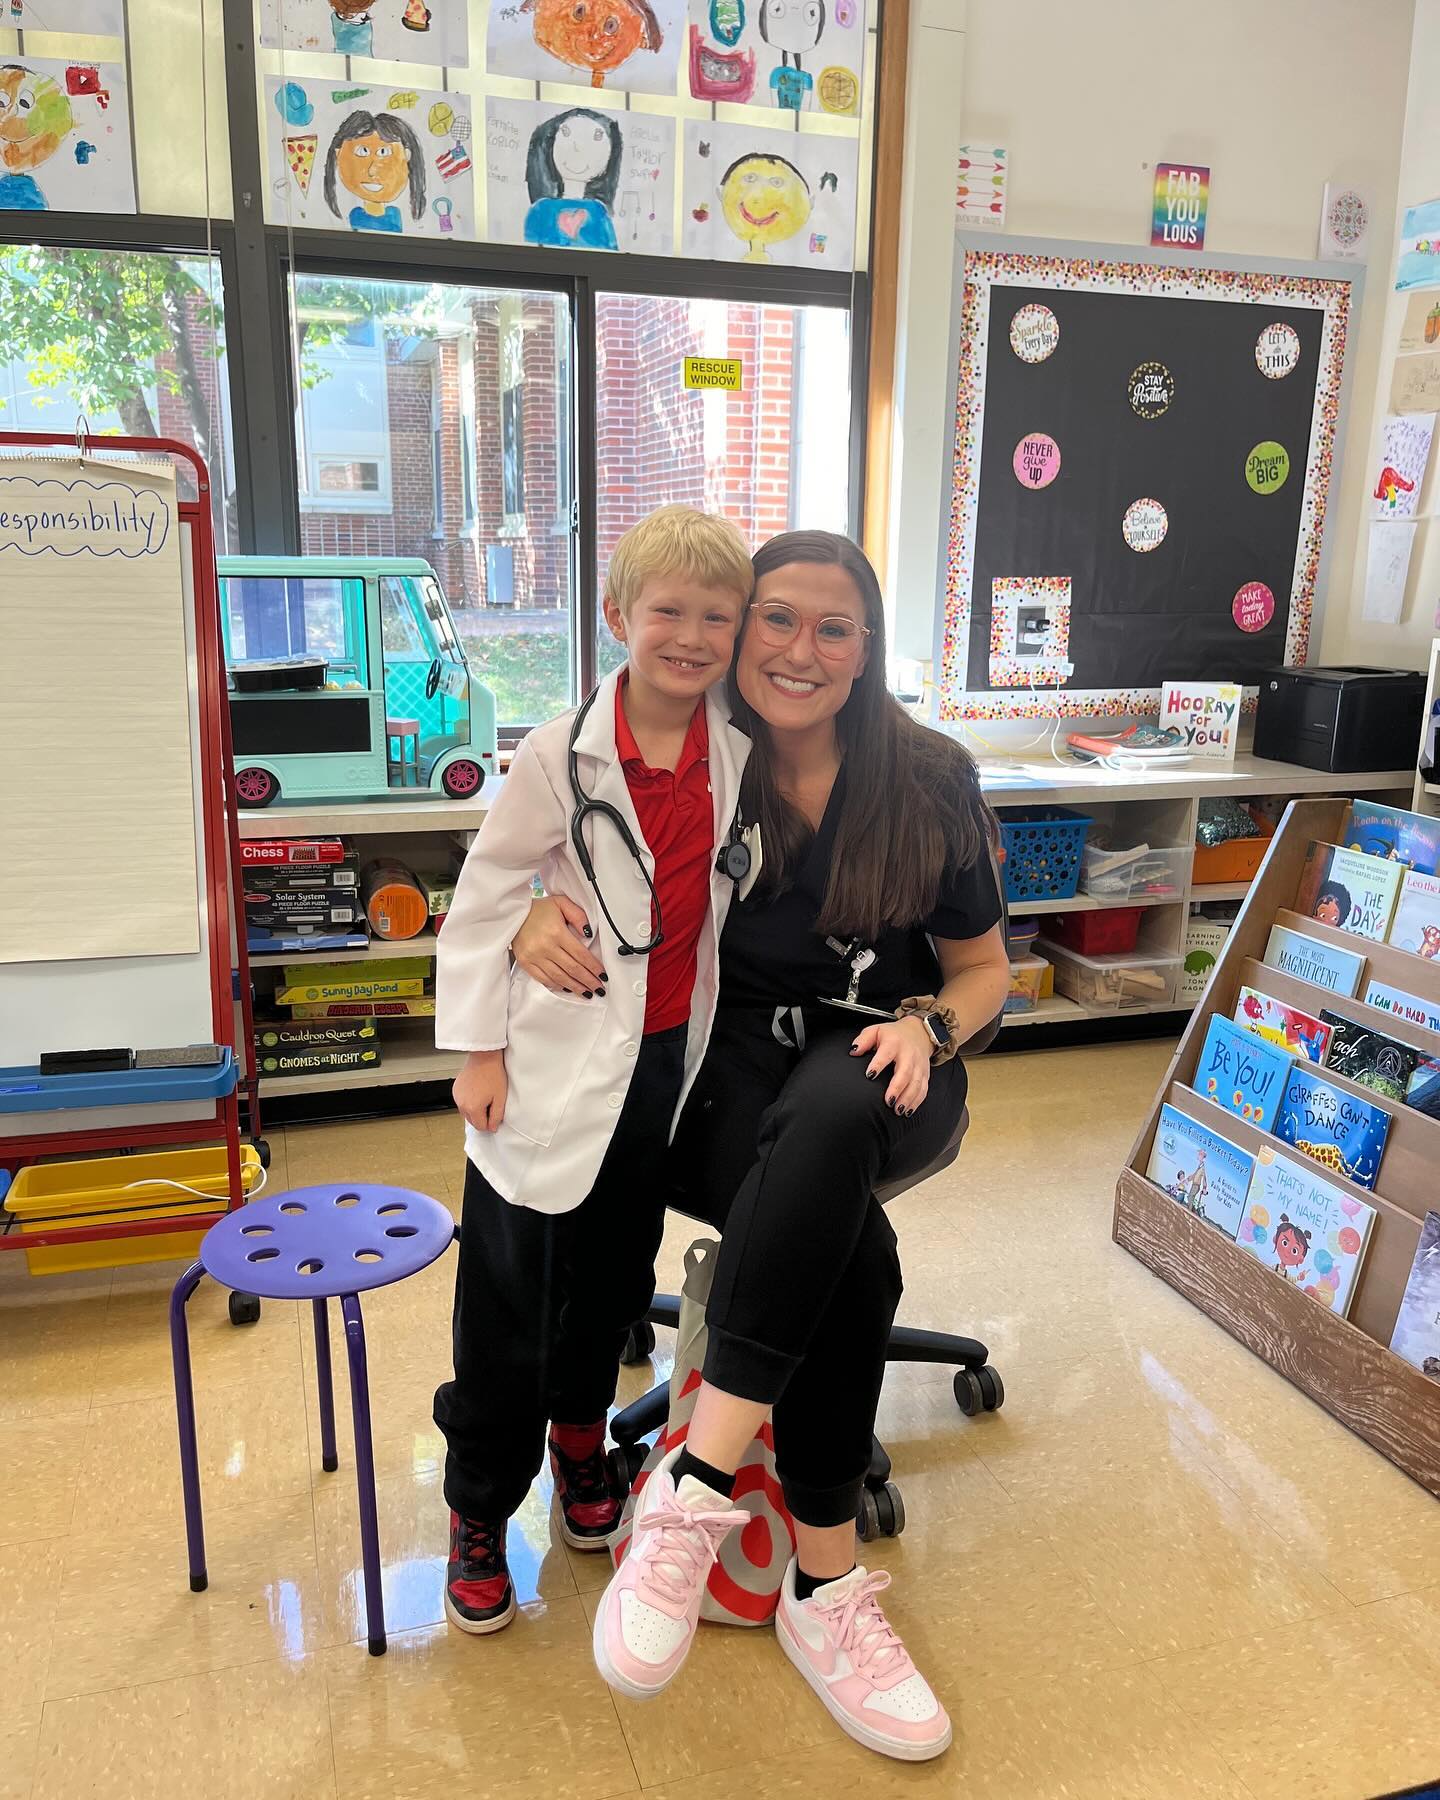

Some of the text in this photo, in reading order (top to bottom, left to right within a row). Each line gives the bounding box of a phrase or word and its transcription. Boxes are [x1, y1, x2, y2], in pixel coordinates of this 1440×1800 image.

[1167, 170, 1201, 196] FAB
[1166, 197, 1200, 223] YOU
[1163, 223, 1198, 244] LOUS
[1269, 331, 1287, 345] LET'S
[691, 362, 735, 374] RESCUE
[1265, 354, 1290, 368] THIS
[691, 374, 736, 386] WINDOW
[1144, 375, 1164, 386] STAY
[1132, 383, 1168, 406] Positive
[1023, 441, 1053, 458] NEVER
[1022, 456, 1047, 471] give
[1249, 455, 1285, 473] Dream
[1256, 465, 1279, 485] BIG
[0, 500, 155, 548] esponsibility
[1241, 589, 1262, 604] MAKE
[1243, 610, 1265, 626] GREAT
[1381, 815, 1392, 825] on
[243, 847, 284, 858] Chess
[275, 893, 296, 901] Solar
[297, 892, 326, 902] System
[1364, 890, 1384, 909] THE
[1351, 904, 1380, 933] DAY
[1298, 945, 1310, 957] THE
[1277, 949, 1340, 989] MAGNIFICENT
[322, 983, 399, 997] Sunny Day Pond
[1368, 993, 1373, 1004] I
[1374, 994, 1391, 1010] CAN
[1405, 1006, 1426, 1024] HARD
[1428, 1016, 1440, 1031] TH
[279, 1028, 358, 1043] Cauldron Quest
[1333, 1027, 1369, 1058] ach
[279, 1057, 321, 1068] GNOMES
[321, 1055, 330, 1063] at
[1208, 1040, 1231, 1075] Be
[1288, 1083, 1370, 1129] GIRAFFES CAN'T
[1304, 1109, 1350, 1140] DANCE
[1162, 1116, 1176, 1129] Have
[1177, 1121, 1188, 1134] You
[1207, 1137, 1227, 1159] Bucket
[1227, 1152, 1249, 1177] Today?
[1275, 1165, 1333, 1212] THAT'S NOT
[1277, 1191, 1293, 1209] MY
